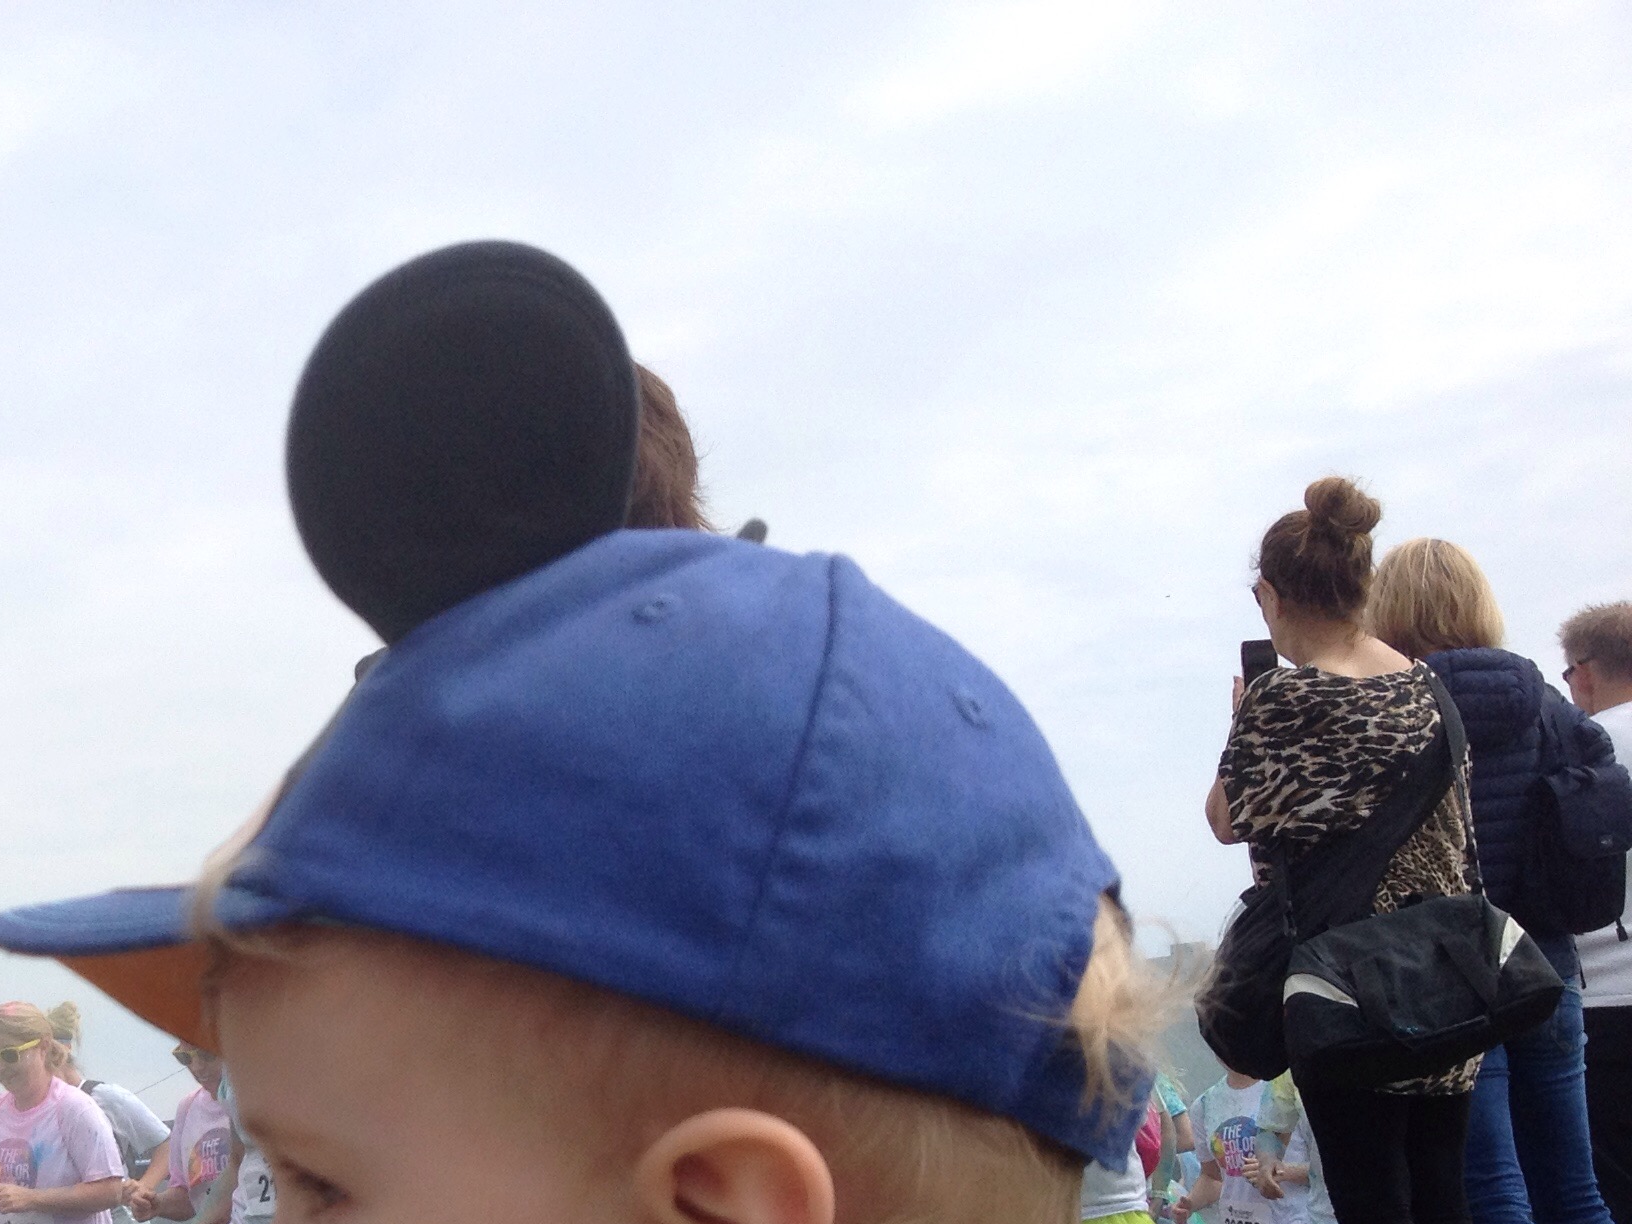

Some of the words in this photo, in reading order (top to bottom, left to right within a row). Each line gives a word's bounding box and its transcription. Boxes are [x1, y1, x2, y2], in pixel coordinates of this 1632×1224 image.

[1223, 1123, 1243, 1141] THE
[0, 1147, 23, 1164] THE
[202, 1137, 221, 1157] THE
